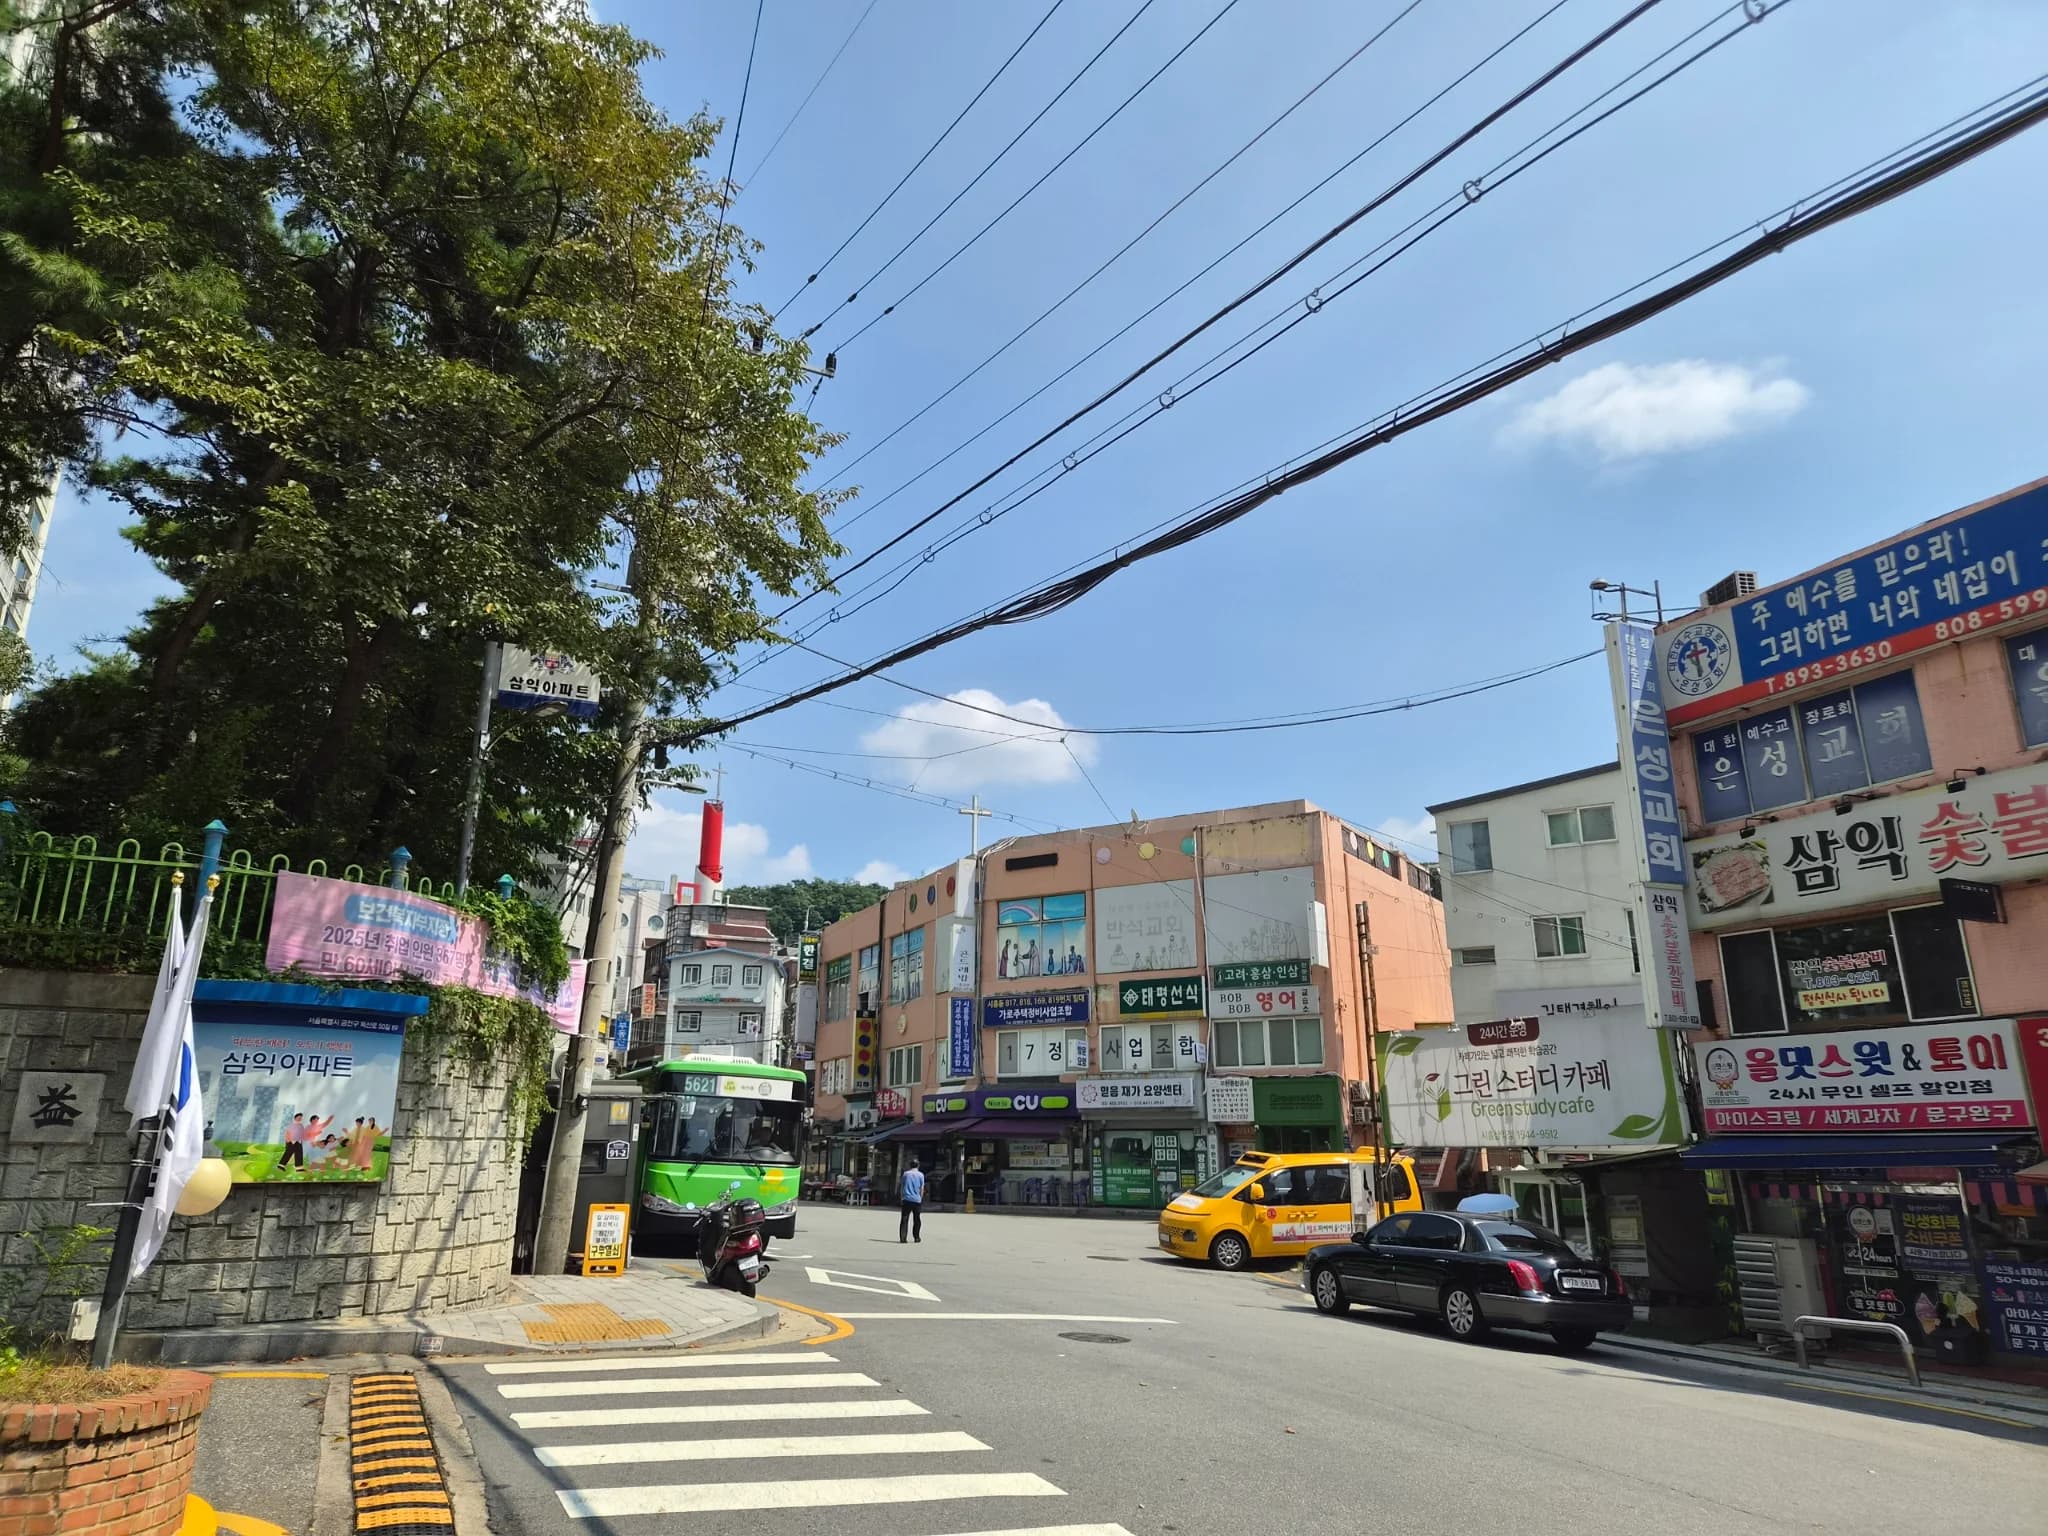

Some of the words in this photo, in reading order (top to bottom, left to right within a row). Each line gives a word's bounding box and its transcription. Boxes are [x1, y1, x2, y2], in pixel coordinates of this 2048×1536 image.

[1751, 600, 1772, 631] 주
[1785, 567, 1858, 617] 예수를
[1874, 528, 1969, 588] 믿으라!
[1759, 610, 1852, 667] 그리하면
[1868, 585, 1921, 628] 너와
[1933, 550, 2020, 605] 네집이
[1765, 641, 1893, 694] T.893-3630
[509, 676, 590, 699] 삼익아파트
[1747, 718, 1790, 740] 예수교
[1805, 700, 1852, 725] 장로회
[1632, 699, 1683, 872] 은성교회
[1783, 815, 1908, 897] 삼익
[1652, 894, 1678, 914] 삼익
[323, 926, 380, 950] 2025년
[384, 933, 410, 957] 취업
[412, 940, 434, 962] 인원
[1660, 915, 1688, 1014] 숯불갈비
[1803, 970, 1880, 990] T.803-9291
[1141, 984, 1198, 1007] 태명선식
[1220, 993, 1242, 1003] BOB
[1255, 990, 1296, 1012] 영어
[1802, 992, 1848, 1007] 점심식사
[1849, 987, 1885, 1003] 됩니다
[998, 1005, 1072, 1020] 가로주택정비사업조합
[1228, 1004, 1251, 1014] BOB
[1479, 1025, 1508, 1040] 24시간
[1528, 1044, 1557, 1057] 학습공간
[1901, 1043, 1922, 1071] &
[1927, 1033, 2008, 1072] 토이
[222, 1052, 353, 1078] 삼익아파트
[684, 1076, 716, 1093] 5621
[1453, 1069, 1493, 1098] 그린
[1562, 1059, 1612, 1093] 카페
[1100, 1086, 1118, 1097] 믿음
[1121, 1085, 1140, 1097] 재가
[1143, 1084, 1182, 1097] 요양센터
[1769, 1087, 1815, 1100] 24시
[1821, 1085, 1864, 1099] 무인
[1869, 1083, 1914, 1098] 셀프
[1920, 1079, 1993, 1096] 할인점
[29, 1084, 82, 1130] 益
[935, 1098, 947, 1113] CU
[1013, 1095, 1039, 1111] CU
[1715, 1110, 1801, 1126] 아이스크림
[1824, 1107, 1901, 1125] 세계과자
[1927, 1105, 2016, 1123] 문구완구
[609, 1149, 626, 1157] 91-2
